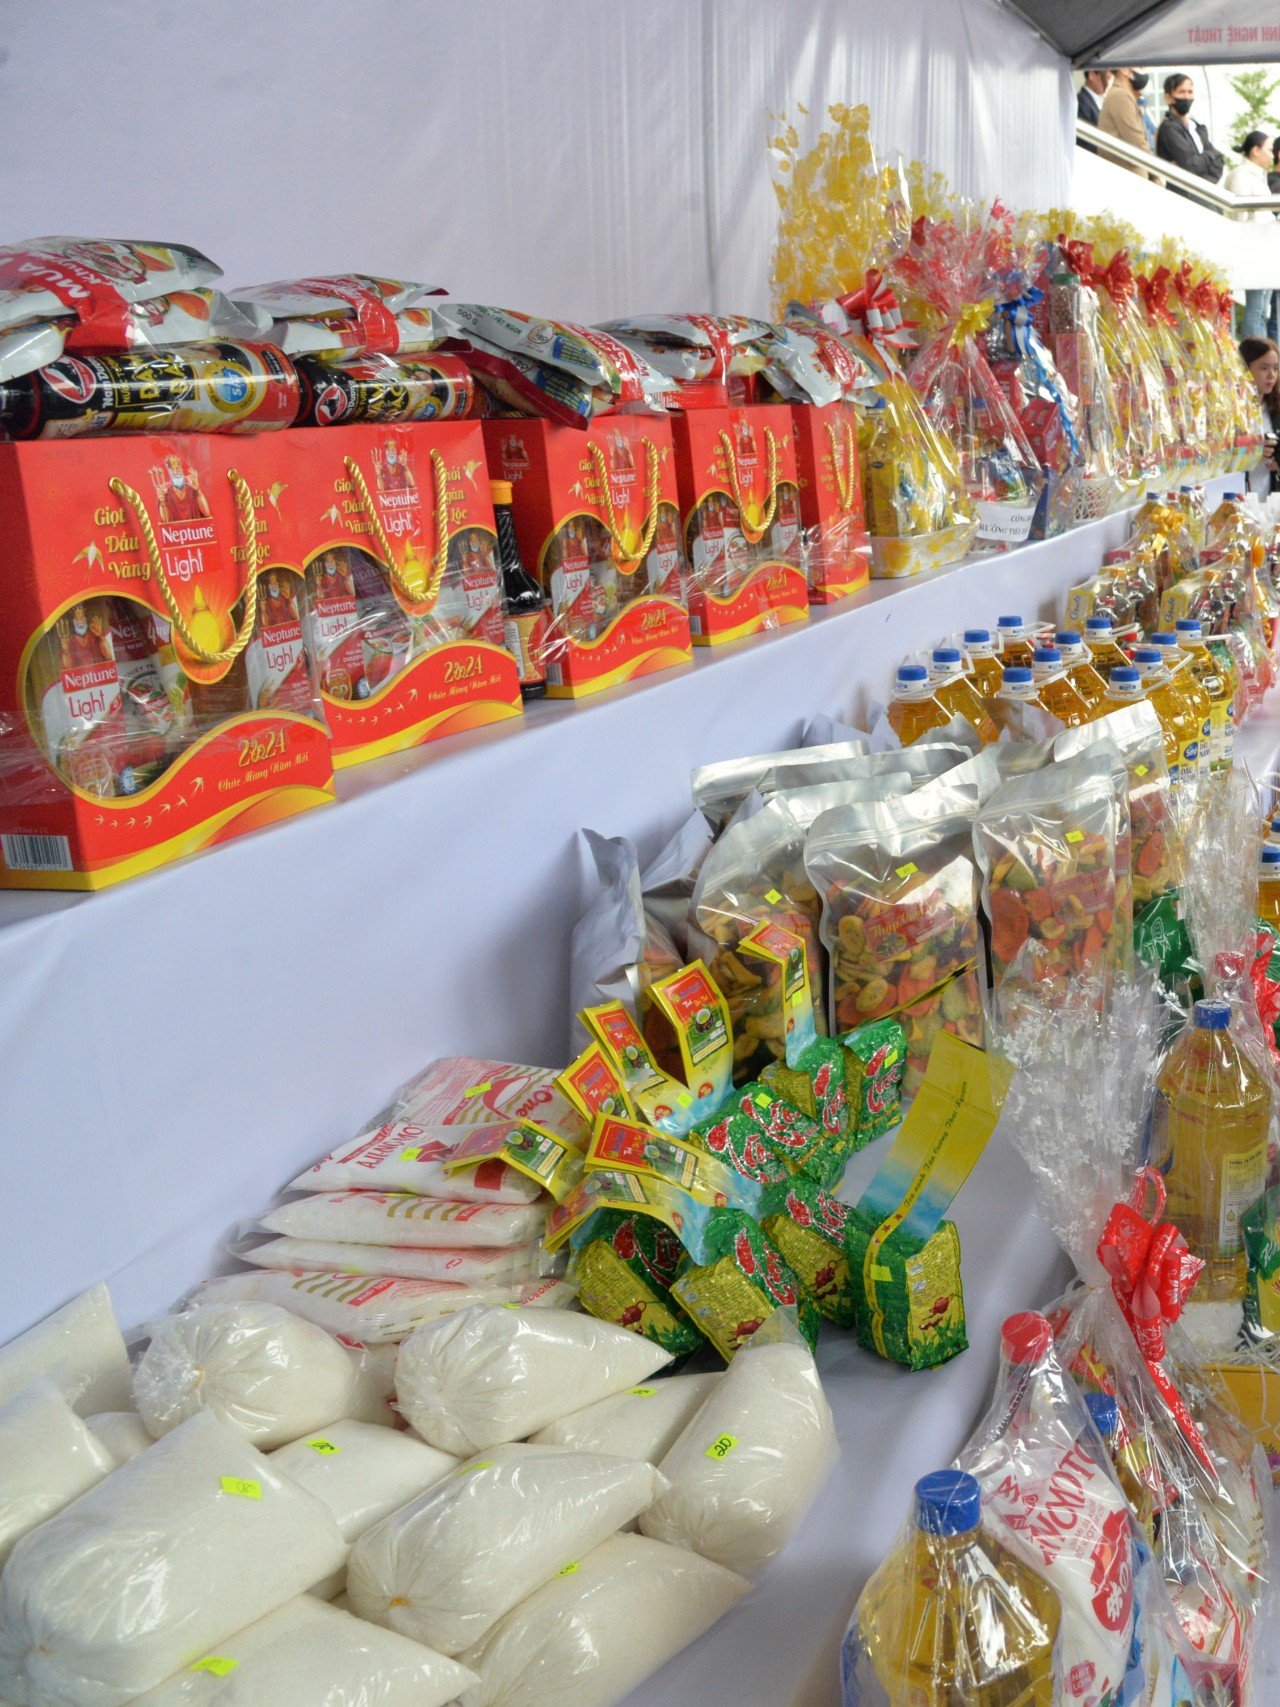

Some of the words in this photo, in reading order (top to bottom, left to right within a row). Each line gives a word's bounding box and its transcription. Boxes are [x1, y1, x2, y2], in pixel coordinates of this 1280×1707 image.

[457, 307, 472, 321] 500
[610, 473, 637, 485] Neptune
[378, 491, 419, 510] Neptune
[611, 487, 630, 508] Light
[94, 506, 126, 527] Giọt
[383, 513, 412, 538] Light
[105, 534, 140, 554] Dầu
[161, 524, 214, 545] Neptune
[108, 561, 151, 581] Vàng
[165, 548, 204, 582] Light
[317, 600, 357, 615] Neptune
[262, 626, 301, 643] Neptune
[266, 648, 295, 674] Light
[443, 653, 484, 684] 2024
[64, 666, 117, 689] Neptune
[68, 690, 106, 721] Light
[238, 727, 287, 768] 2024
